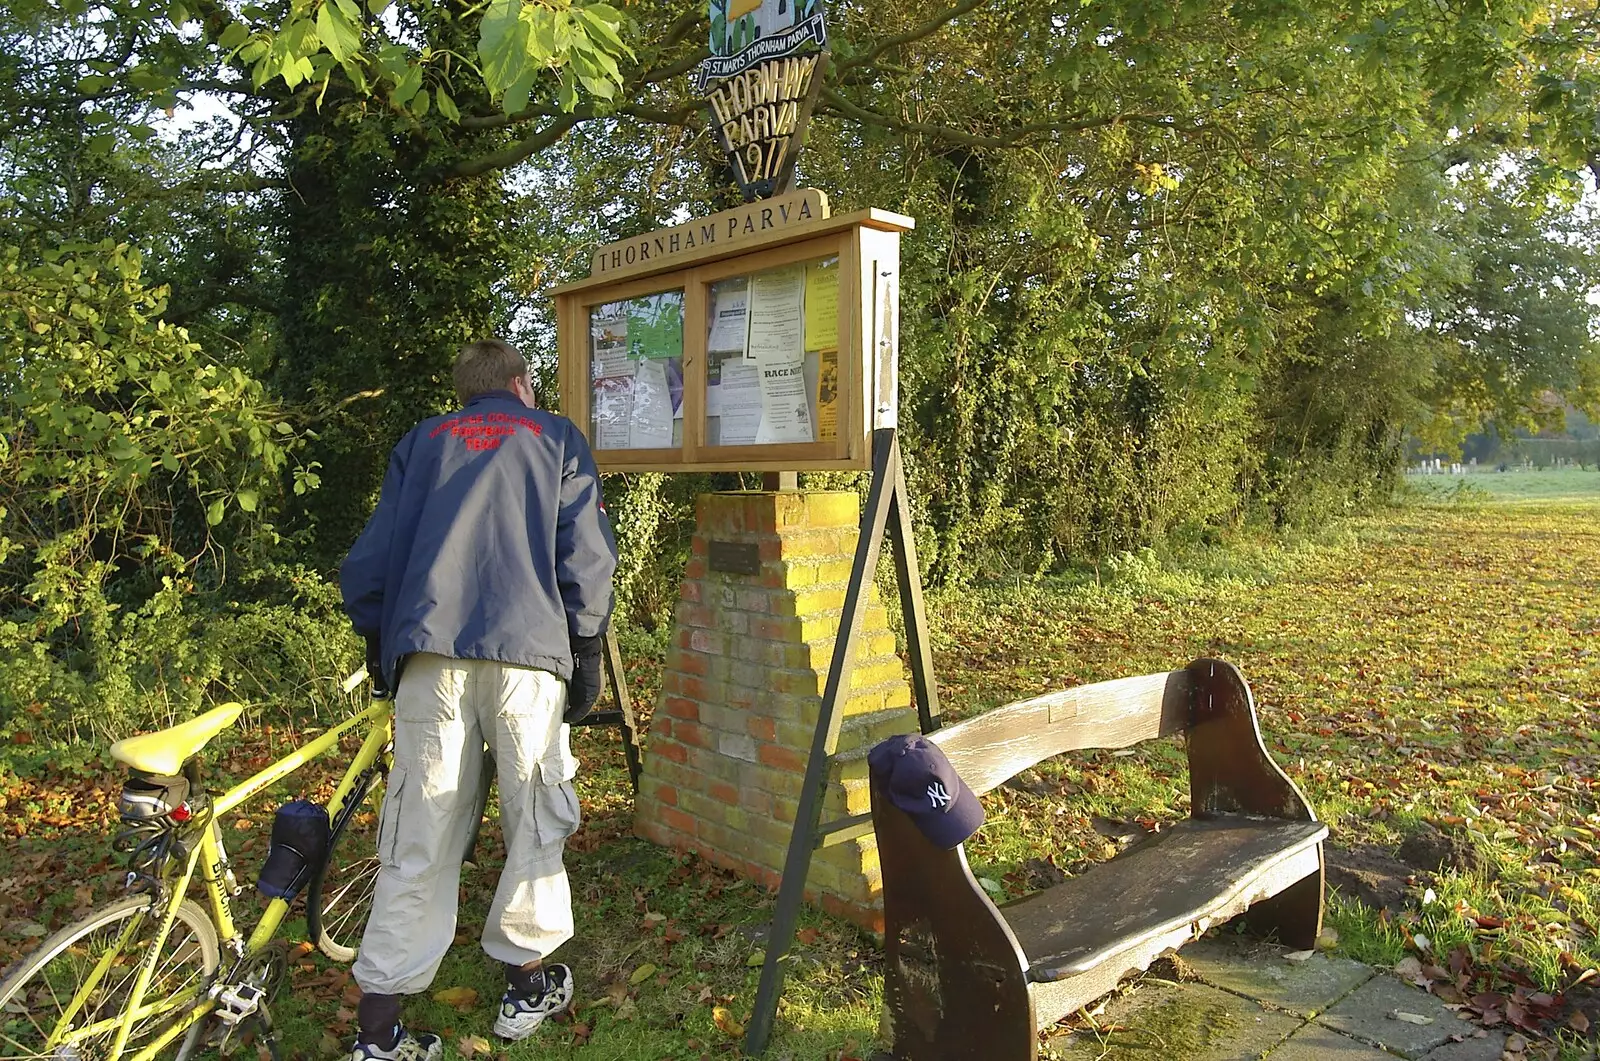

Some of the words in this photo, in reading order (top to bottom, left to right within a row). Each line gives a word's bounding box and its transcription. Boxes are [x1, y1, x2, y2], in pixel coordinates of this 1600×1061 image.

[722, 54, 746, 74] MARYS
[746, 37, 787, 61] THORNHAM
[787, 27, 809, 48] PARVA
[705, 54, 819, 125] THORNHAM
[723, 100, 798, 152] PARVA
[735, 137, 790, 185] 1977
[599, 223, 716, 271] THORNHAM
[728, 198, 812, 238] PARVA
[764, 368, 789, 378] RACE
[452, 425, 516, 437] FOOTBALL
[487, 412, 543, 437] COLLEGE
[466, 438, 501, 451] TEAM
[337, 714, 370, 739] Bianchi
[926, 781, 952, 809] NY
